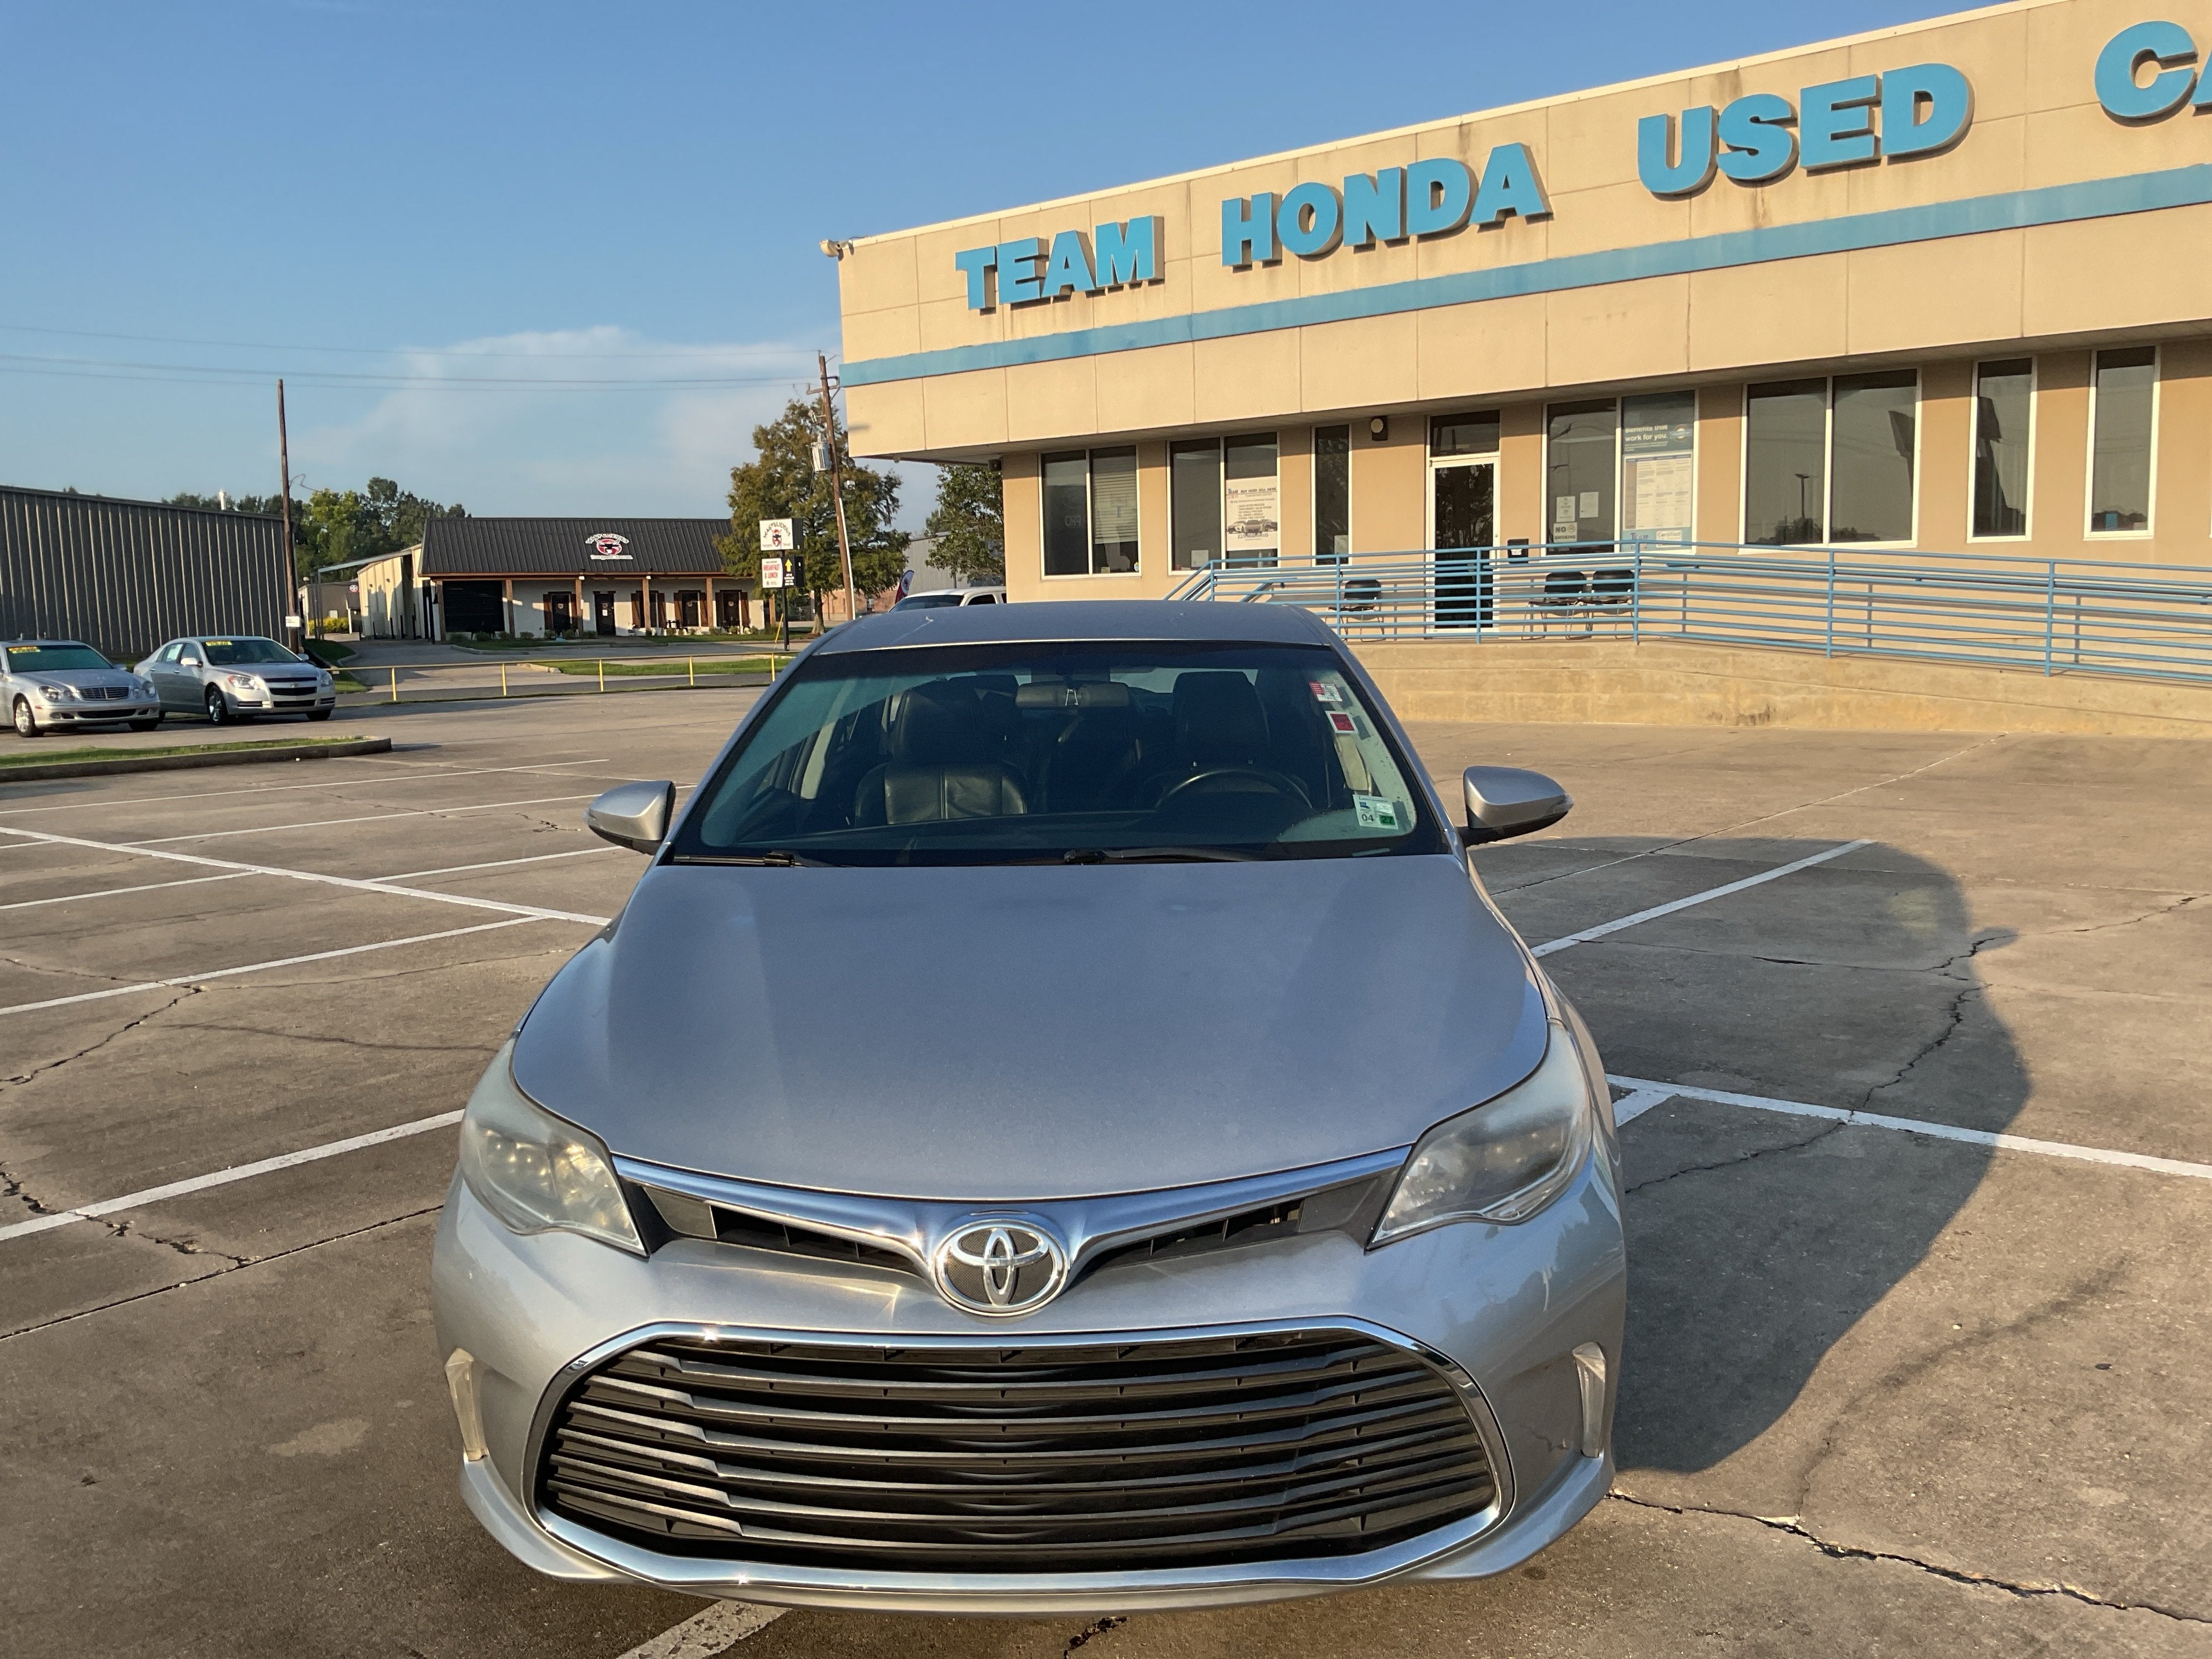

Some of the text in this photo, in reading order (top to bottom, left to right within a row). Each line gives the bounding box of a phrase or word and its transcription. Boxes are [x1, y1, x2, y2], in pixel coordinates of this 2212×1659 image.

[956, 20, 2212, 311] TEAM HONDA USED C
[1361, 814, 1374, 822] 04
